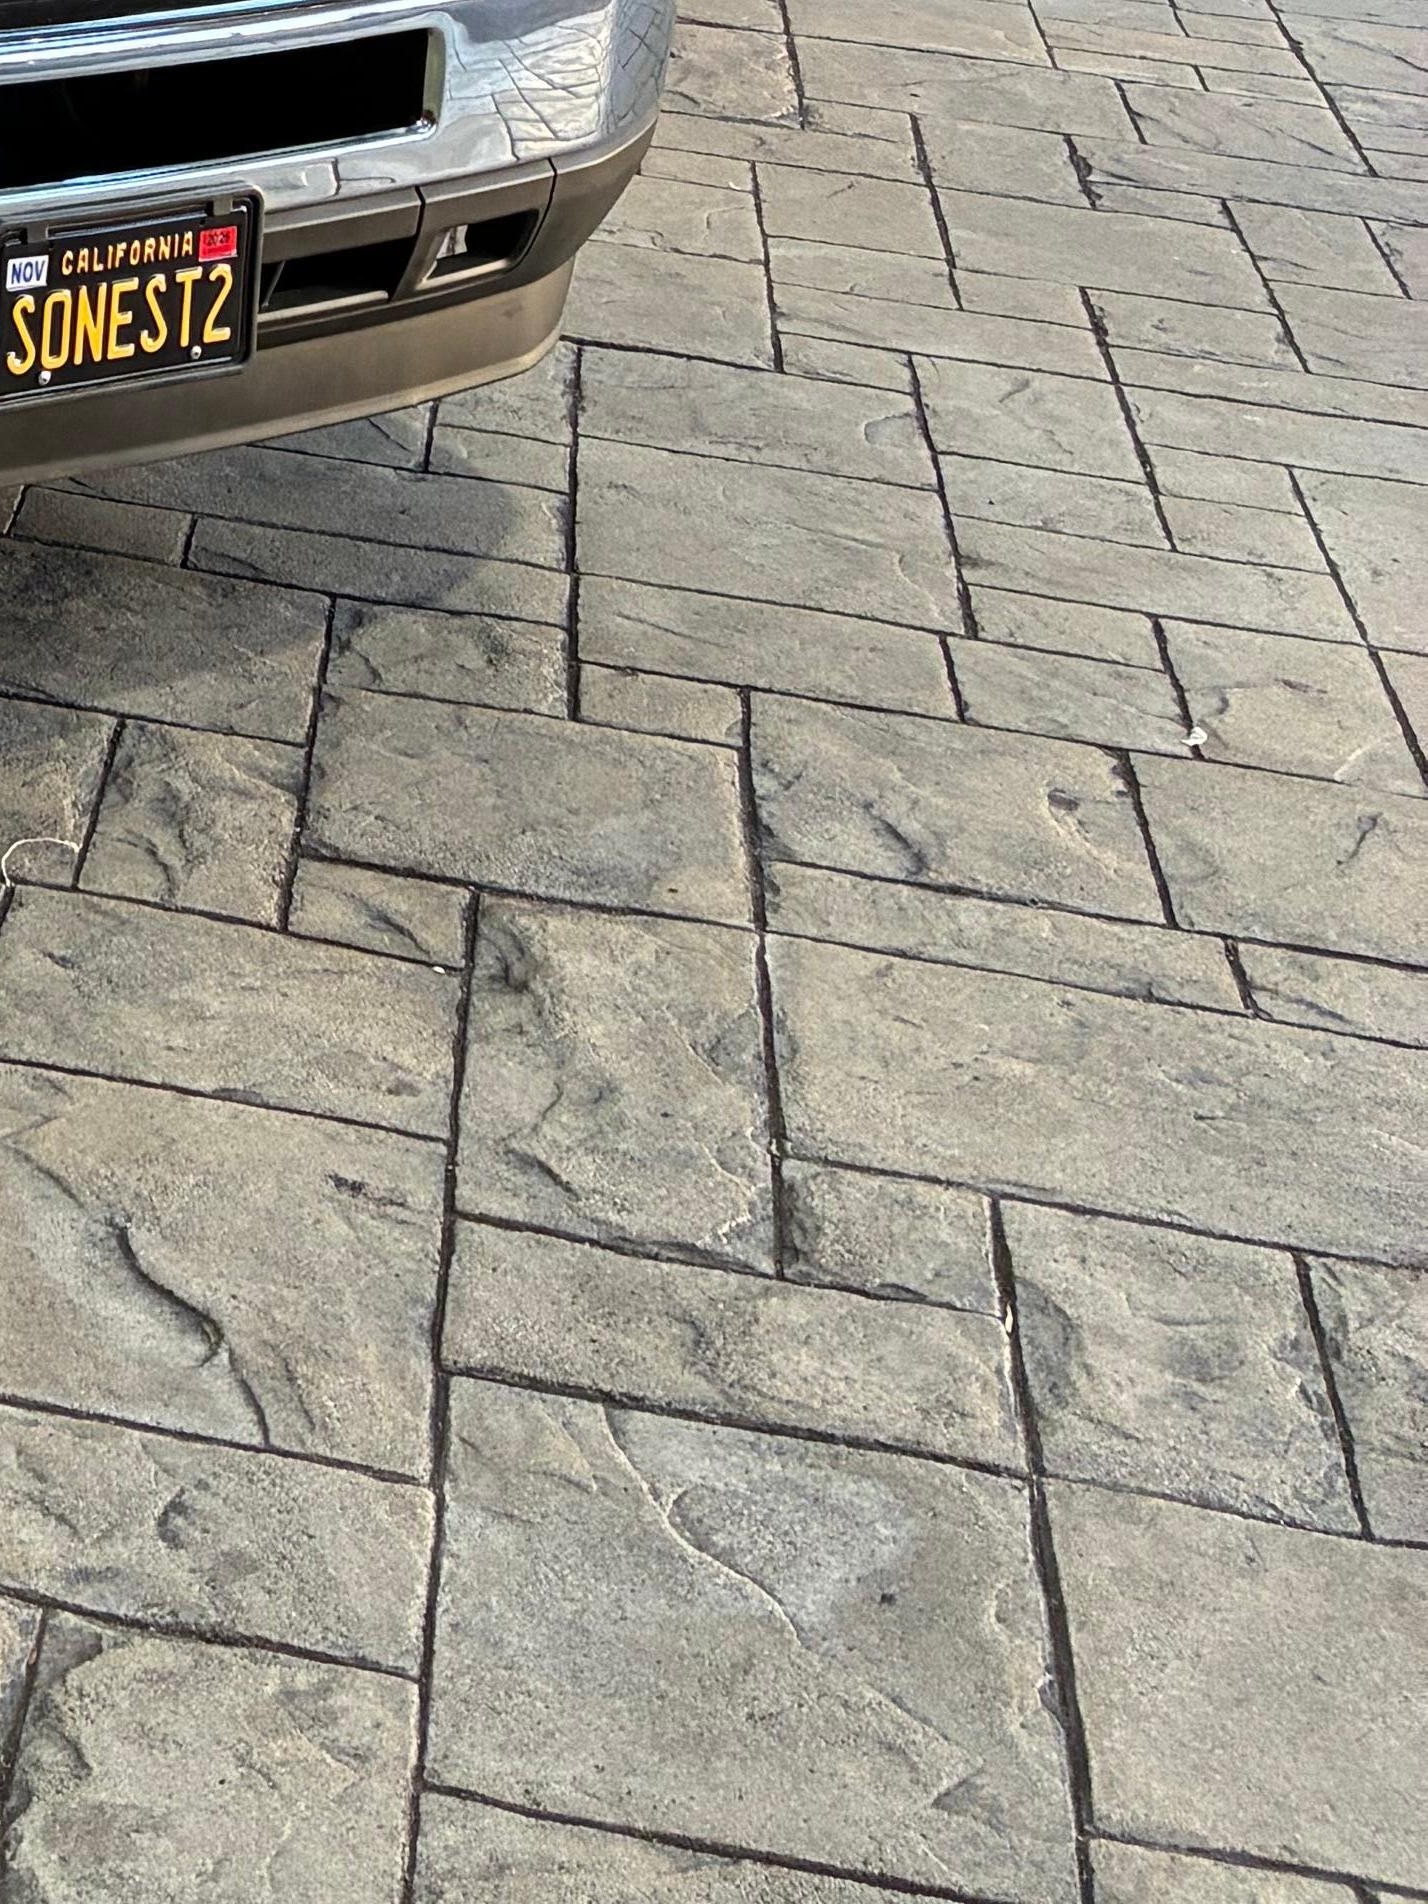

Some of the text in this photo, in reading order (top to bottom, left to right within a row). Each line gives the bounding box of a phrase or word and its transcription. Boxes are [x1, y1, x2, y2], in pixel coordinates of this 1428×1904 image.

[10, 260, 47, 285] NOV
[61, 230, 194, 276] CALIFORNIA
[6, 263, 233, 376] SONEST2
